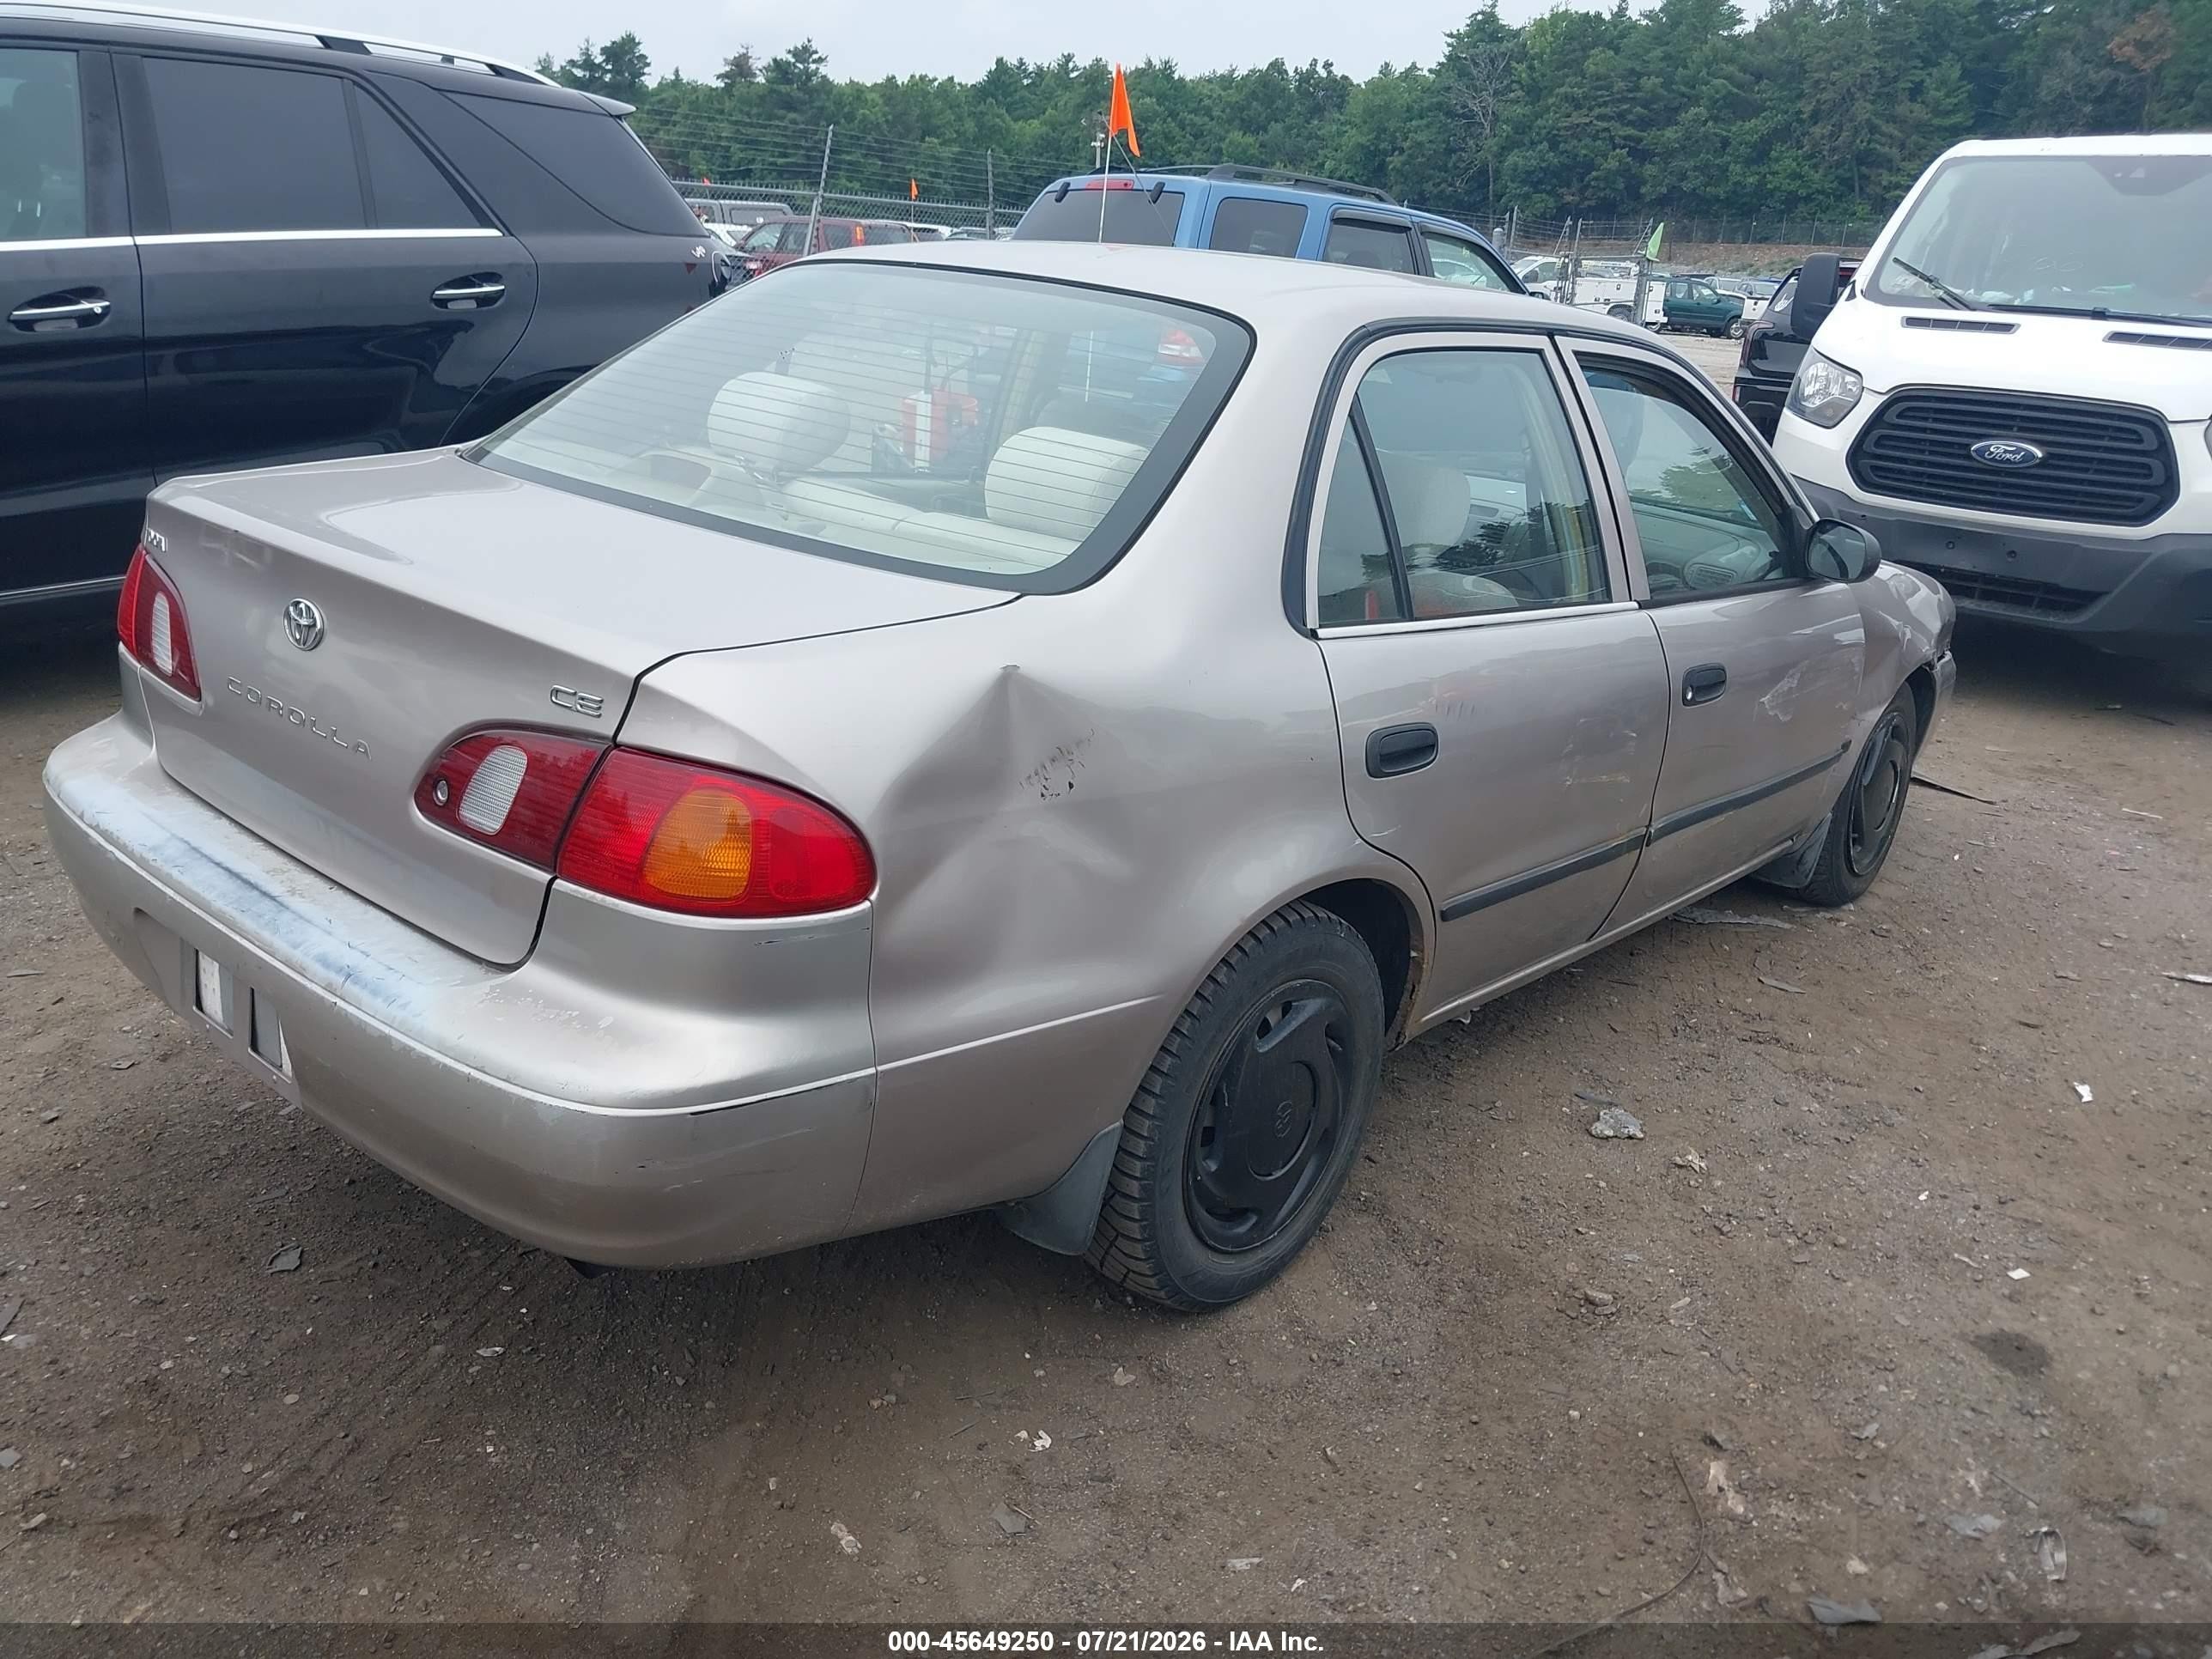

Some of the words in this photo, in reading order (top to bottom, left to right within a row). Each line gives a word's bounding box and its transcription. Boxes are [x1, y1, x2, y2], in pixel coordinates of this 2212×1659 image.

[1984, 444, 2025, 462] Ford
[227, 675, 372, 761] COROLLA
[550, 684, 605, 719] CE
